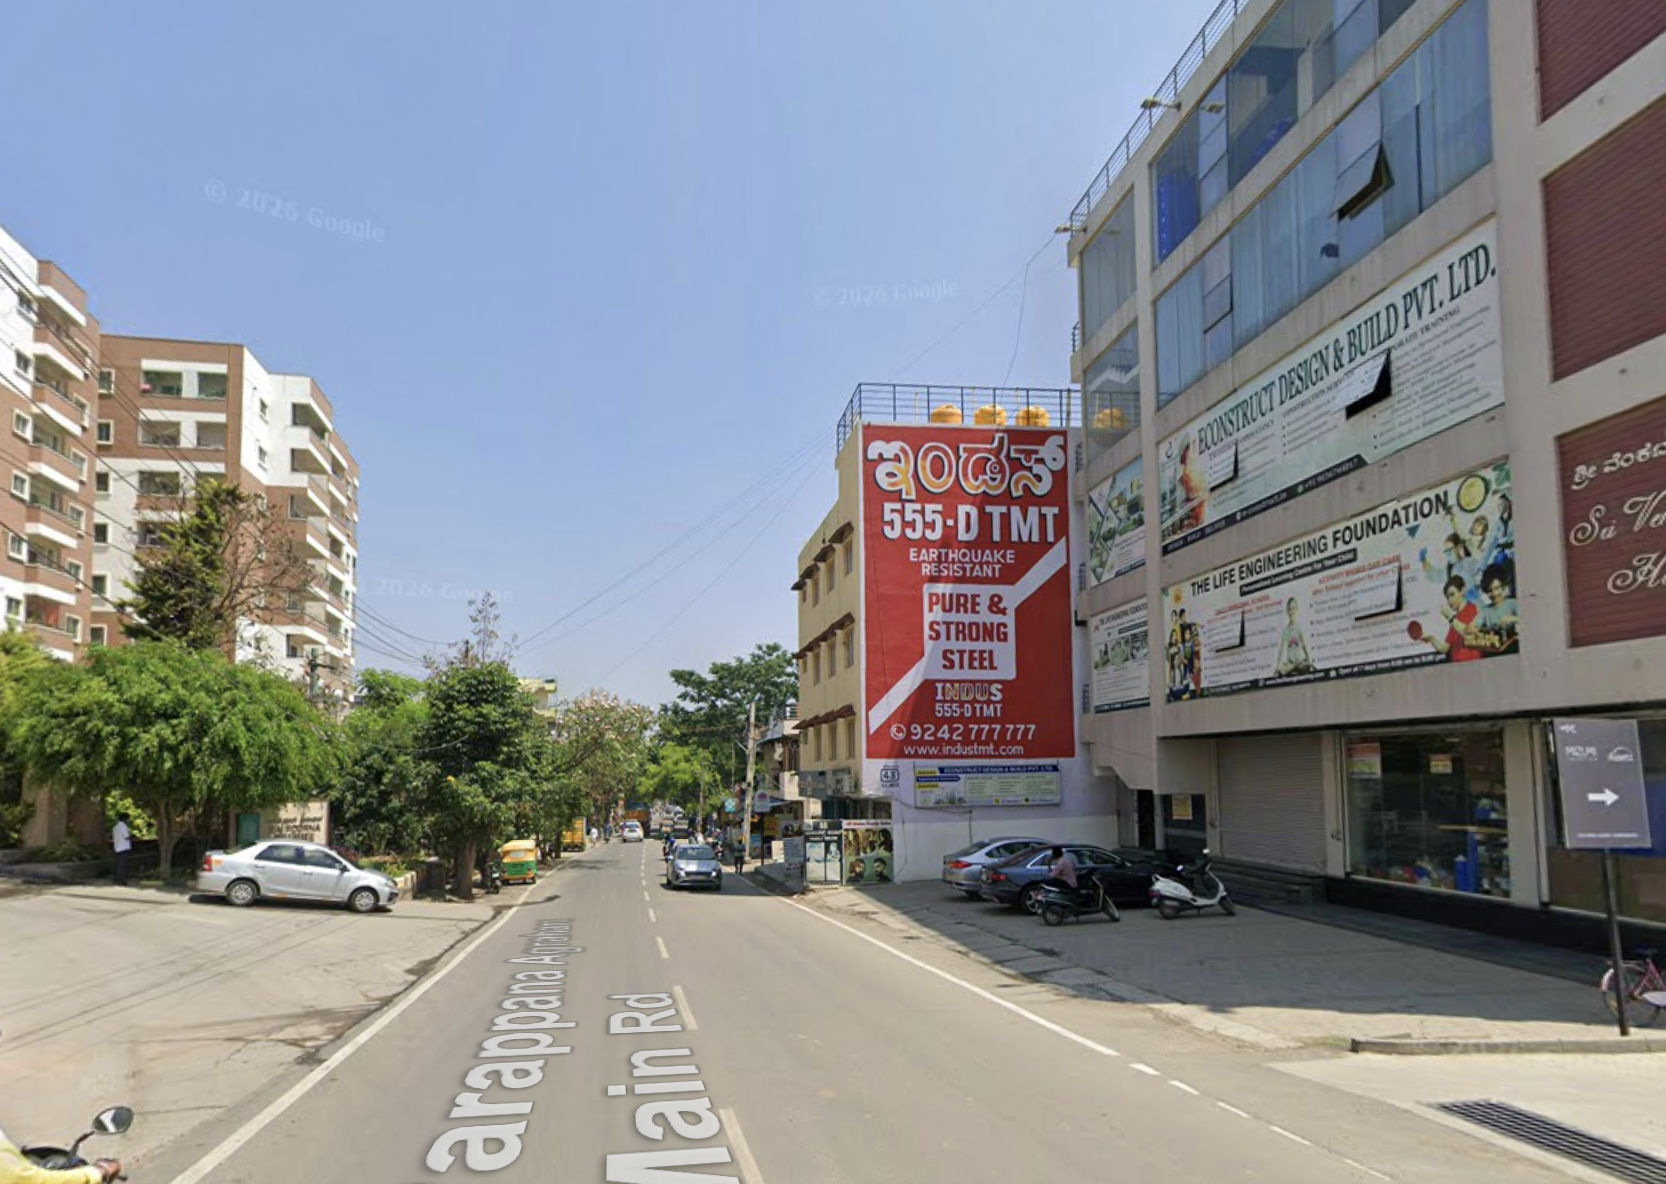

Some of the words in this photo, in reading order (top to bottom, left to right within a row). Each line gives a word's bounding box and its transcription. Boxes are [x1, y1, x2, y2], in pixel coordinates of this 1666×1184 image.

[1198, 380, 1276, 455] ECONSTRUCT
[1278, 344, 1331, 406] DESIGN
[1332, 337, 1345, 372] &
[1346, 302, 1398, 364] BUILD
[1403, 273, 1445, 331] PVT.
[1447, 243, 1496, 302] LTD.
[883, 502, 979, 542] 555-D
[984, 505, 1060, 543] TMT
[1190, 576, 1211, 598] THE
[1212, 569, 1236, 590] LIFE
[1238, 536, 1329, 581] ENGINEERING
[1332, 490, 1449, 549] FOUNDATION
[909, 548, 1016, 564] EARTHQUAKE
[921, 563, 1003, 578] RESISTANT
[928, 592, 981, 615] PURE
[987, 593, 1008, 616] &
[928, 620, 1008, 643] STRONG
[942, 648, 998, 671] STEEL
[934, 683, 1004, 701] INDUS
[974, 703, 1003, 718] TMT
[910, 724, 964, 741] 9242
[968, 724, 1001, 741] 777
[1005, 724, 1036, 741] 777
[903, 742, 1024, 756] www.industmt.com
